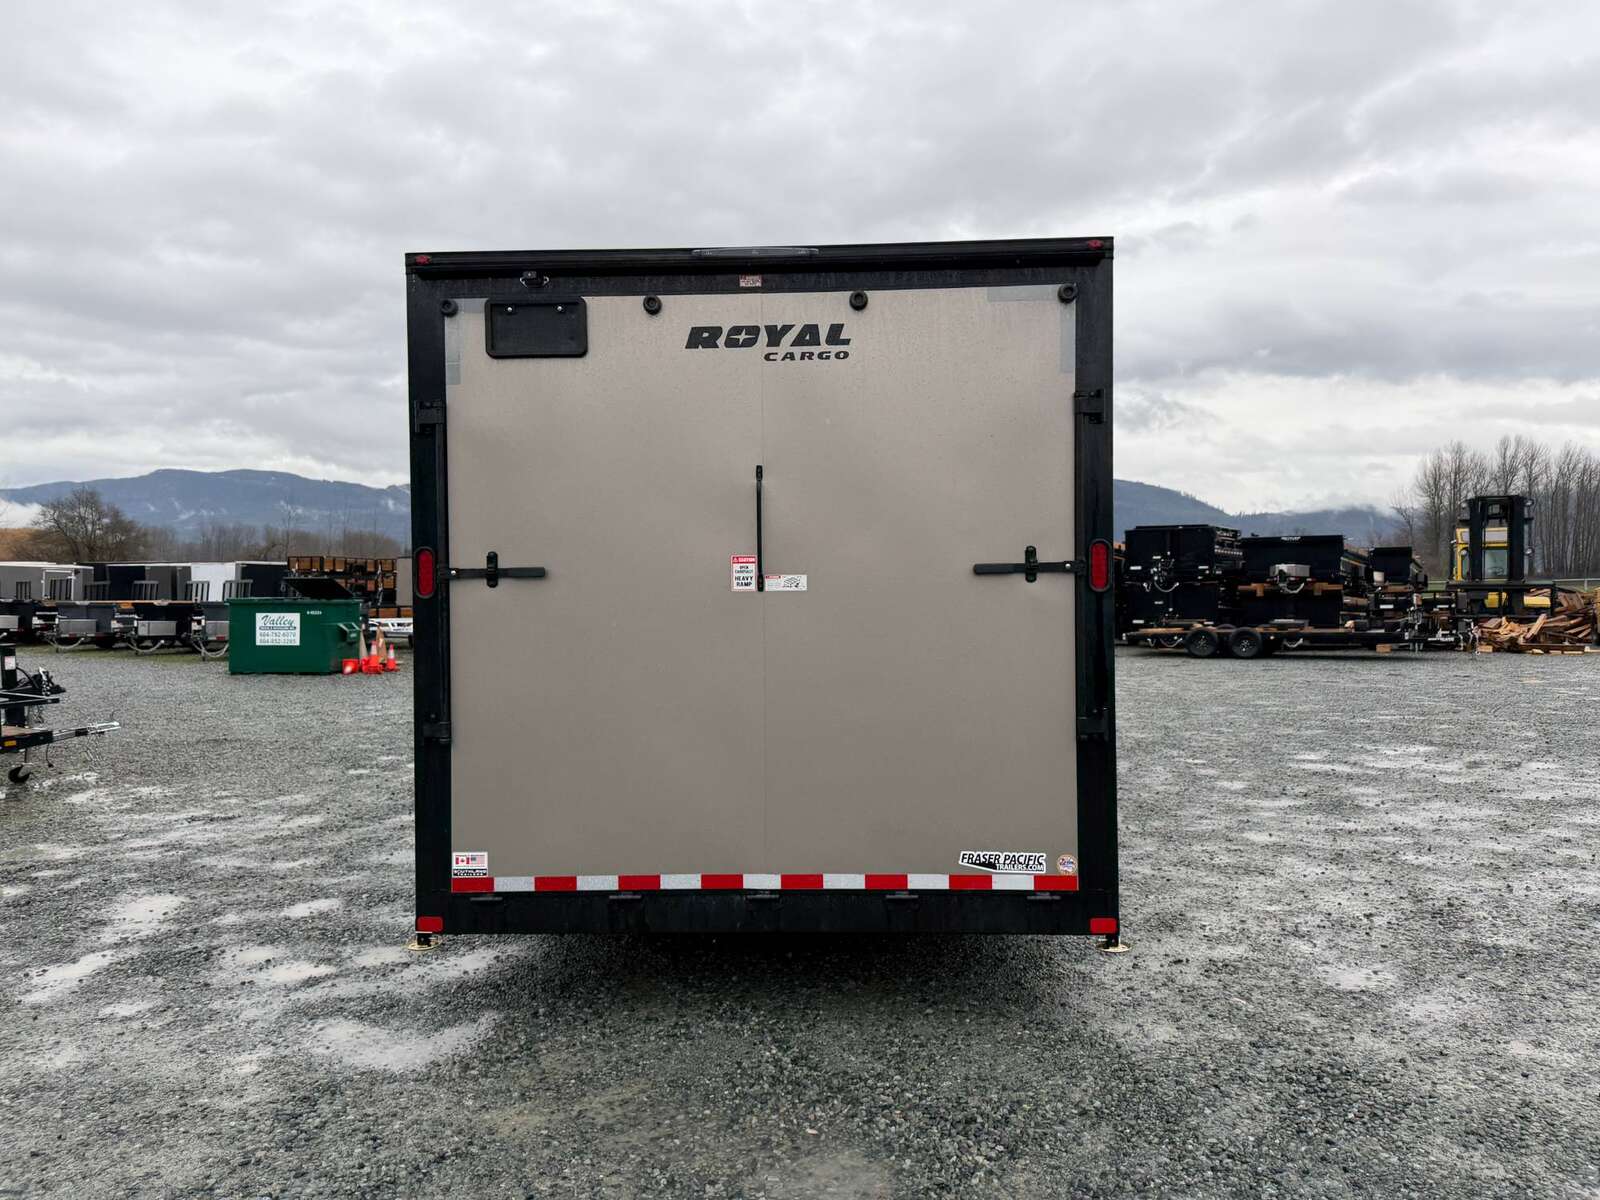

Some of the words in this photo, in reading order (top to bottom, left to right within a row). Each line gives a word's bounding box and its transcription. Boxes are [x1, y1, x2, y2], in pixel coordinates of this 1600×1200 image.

[685, 323, 851, 349] ROYAL
[764, 351, 849, 361] CARGO
[261, 615, 294, 627] Valley
[961, 852, 1000, 864] FRASER
[1003, 854, 1044, 865] PACIFIC
